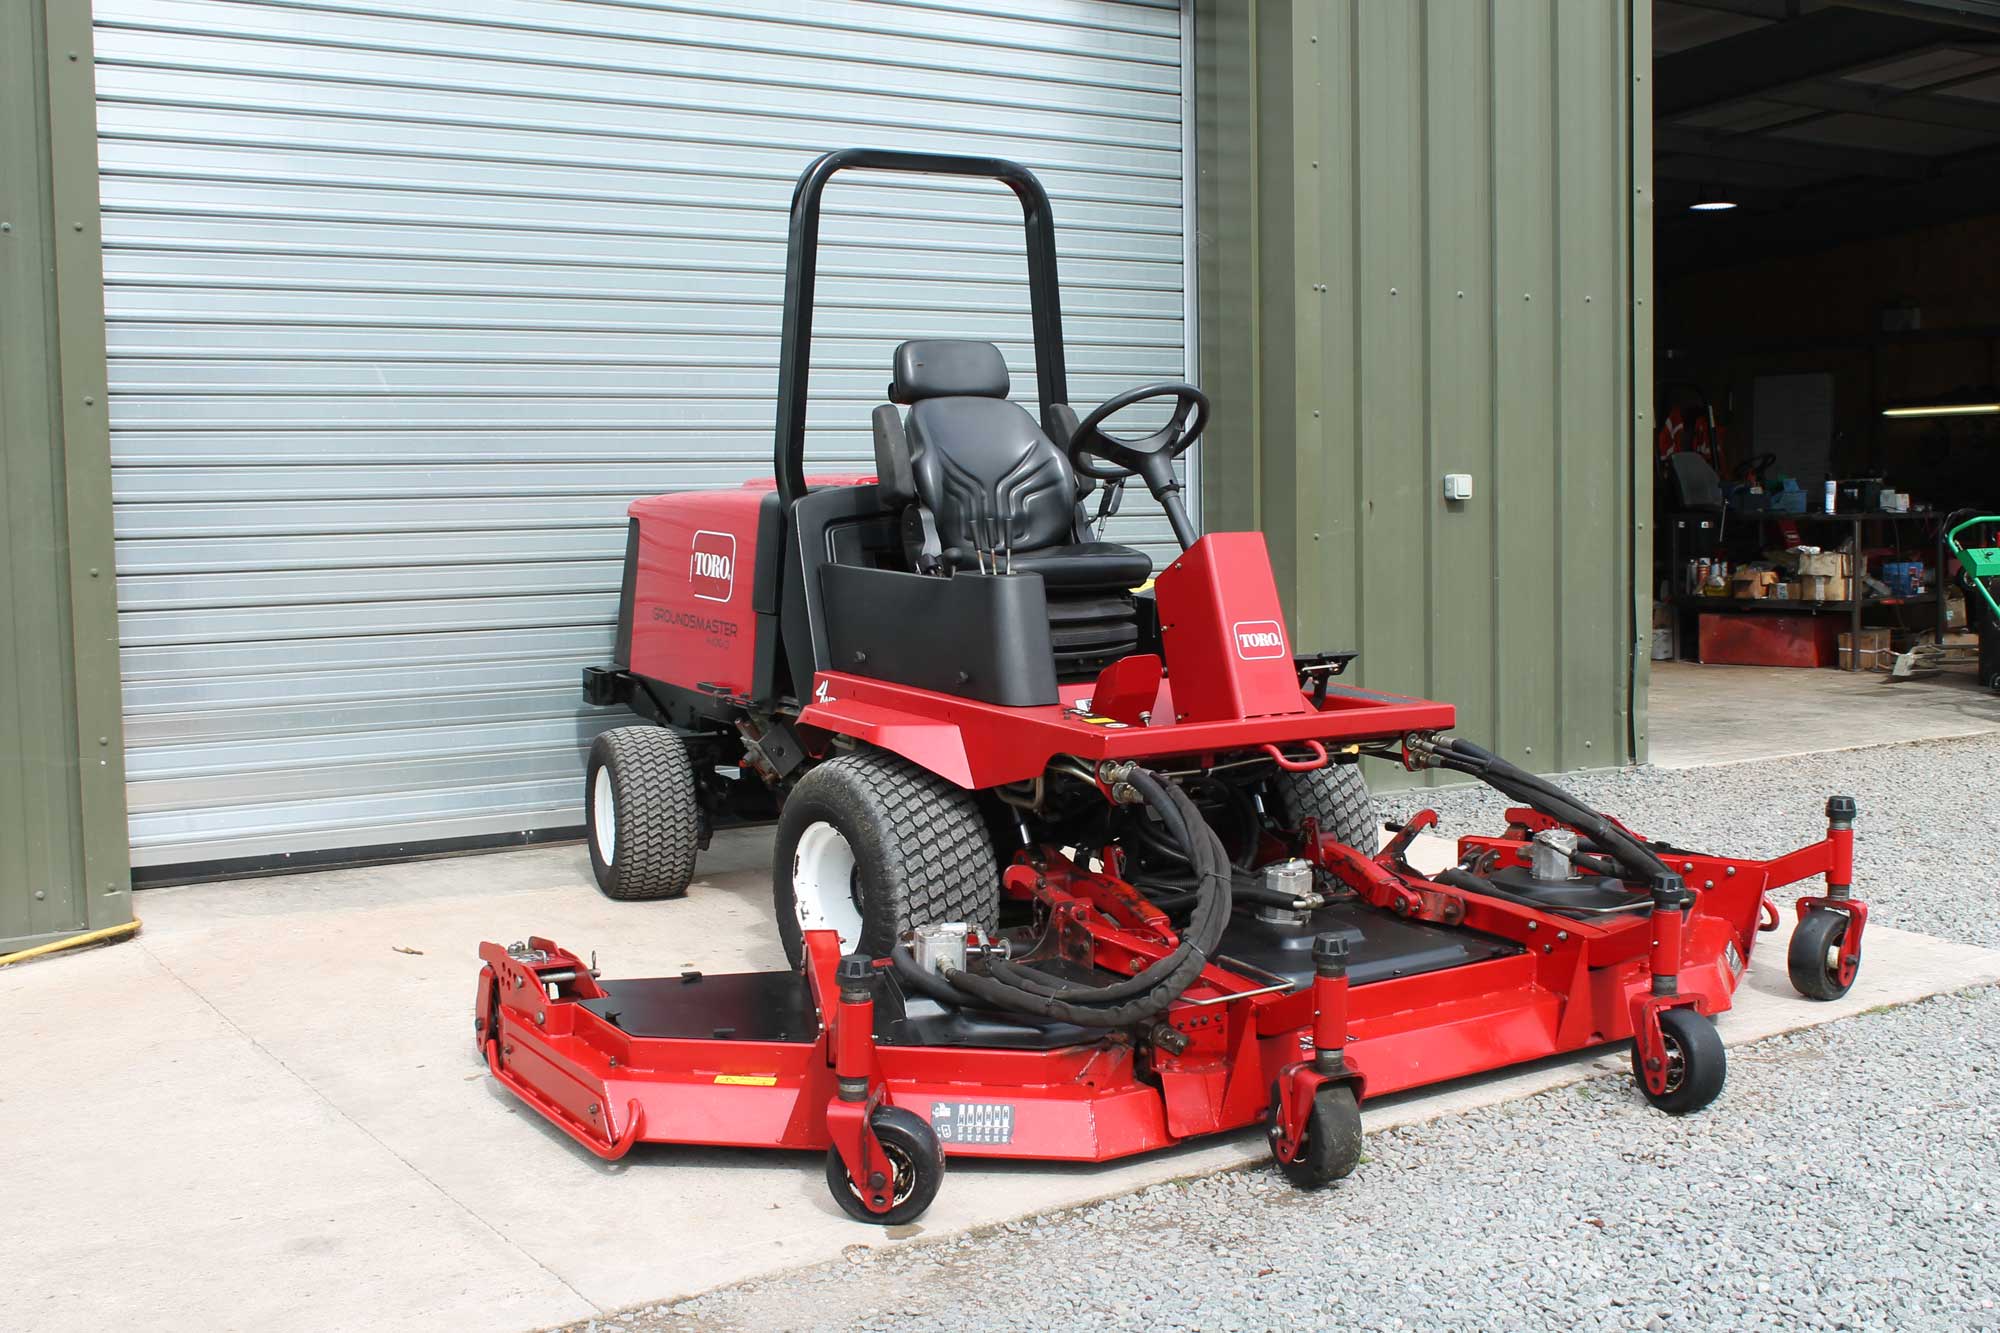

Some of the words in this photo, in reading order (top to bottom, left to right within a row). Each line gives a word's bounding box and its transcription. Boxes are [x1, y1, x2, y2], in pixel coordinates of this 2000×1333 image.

[694, 552, 731, 580] TORO
[652, 607, 738, 637] GROUNDSMASTER
[1239, 632, 1280, 648] TORO
